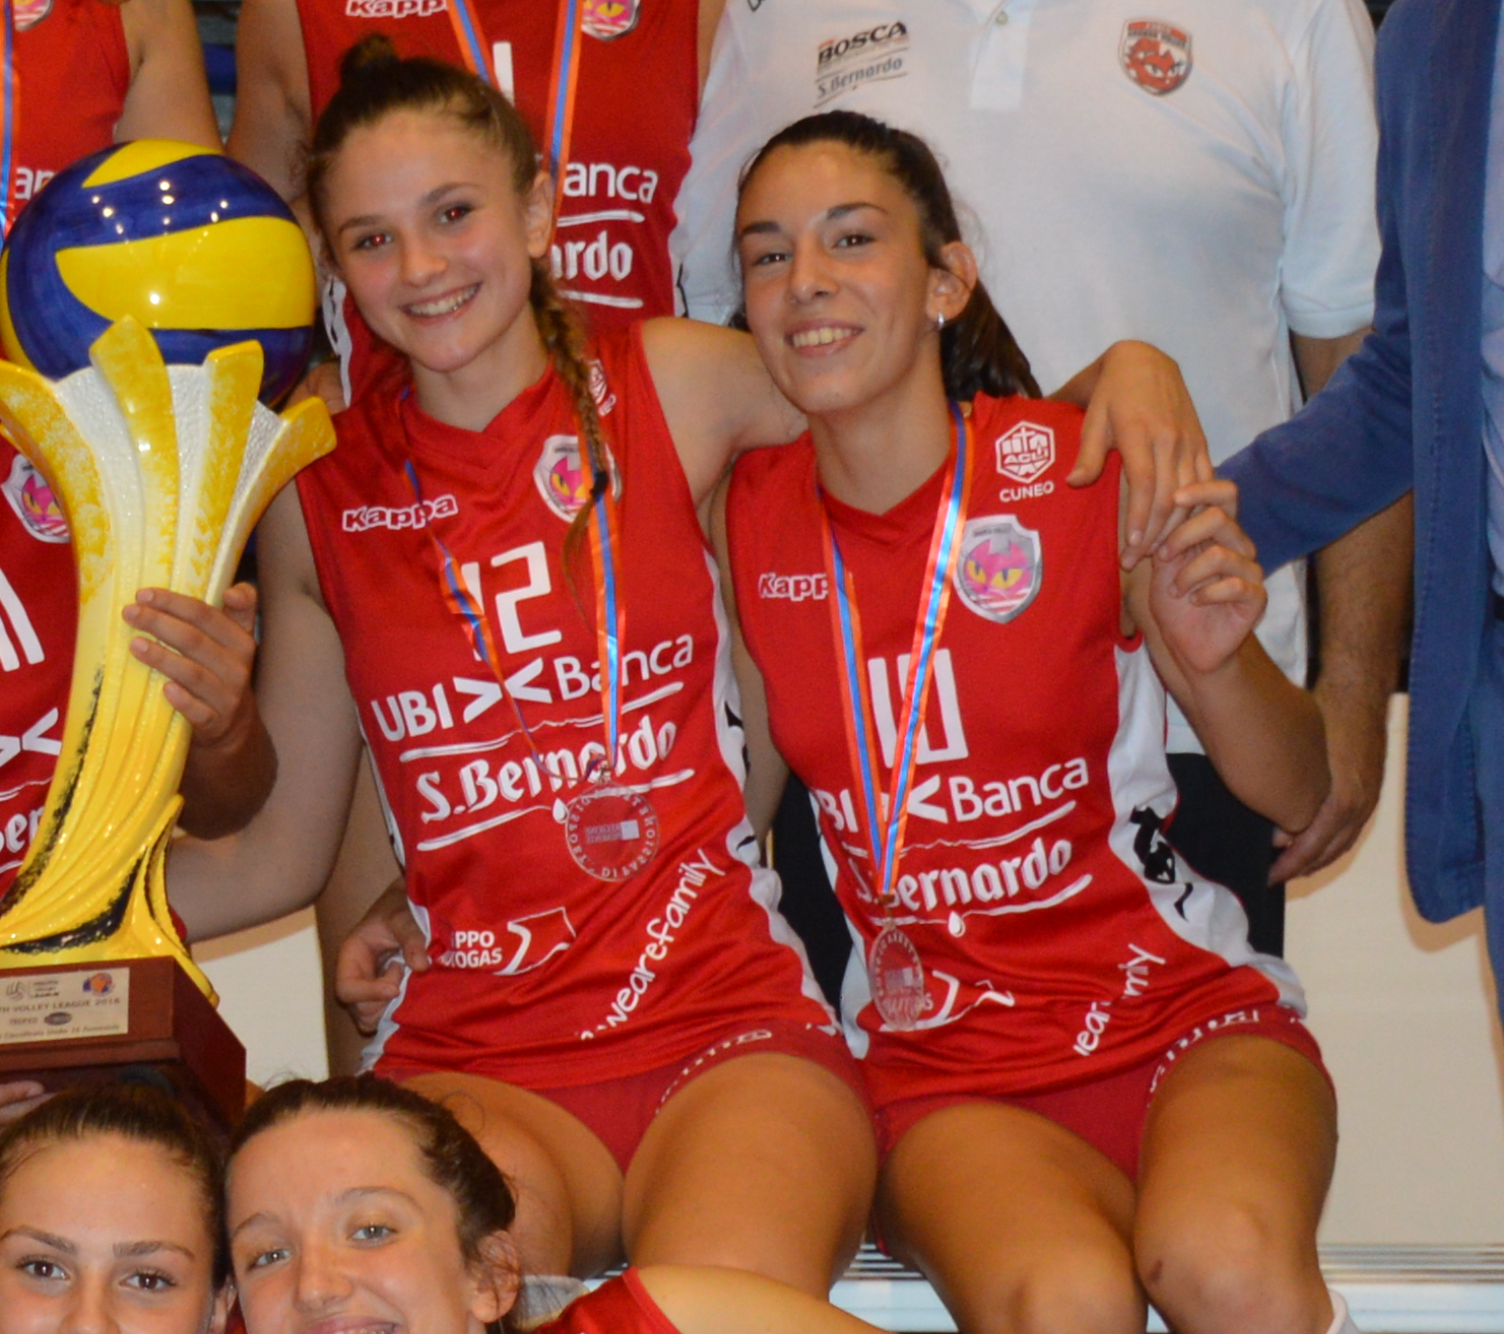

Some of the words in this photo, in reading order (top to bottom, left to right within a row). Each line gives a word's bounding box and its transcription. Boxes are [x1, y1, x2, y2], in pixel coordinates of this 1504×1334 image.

[816, 21, 909, 67] BOSCA
[562, 161, 659, 204] anca
[342, 495, 459, 532] Kappa
[999, 480, 1055, 503] CUNEO
[459, 542, 562, 661] 12
[758, 573, 830, 601] Kapp
[371, 683, 453, 743] UBI
[949, 757, 1089, 822] Banca
